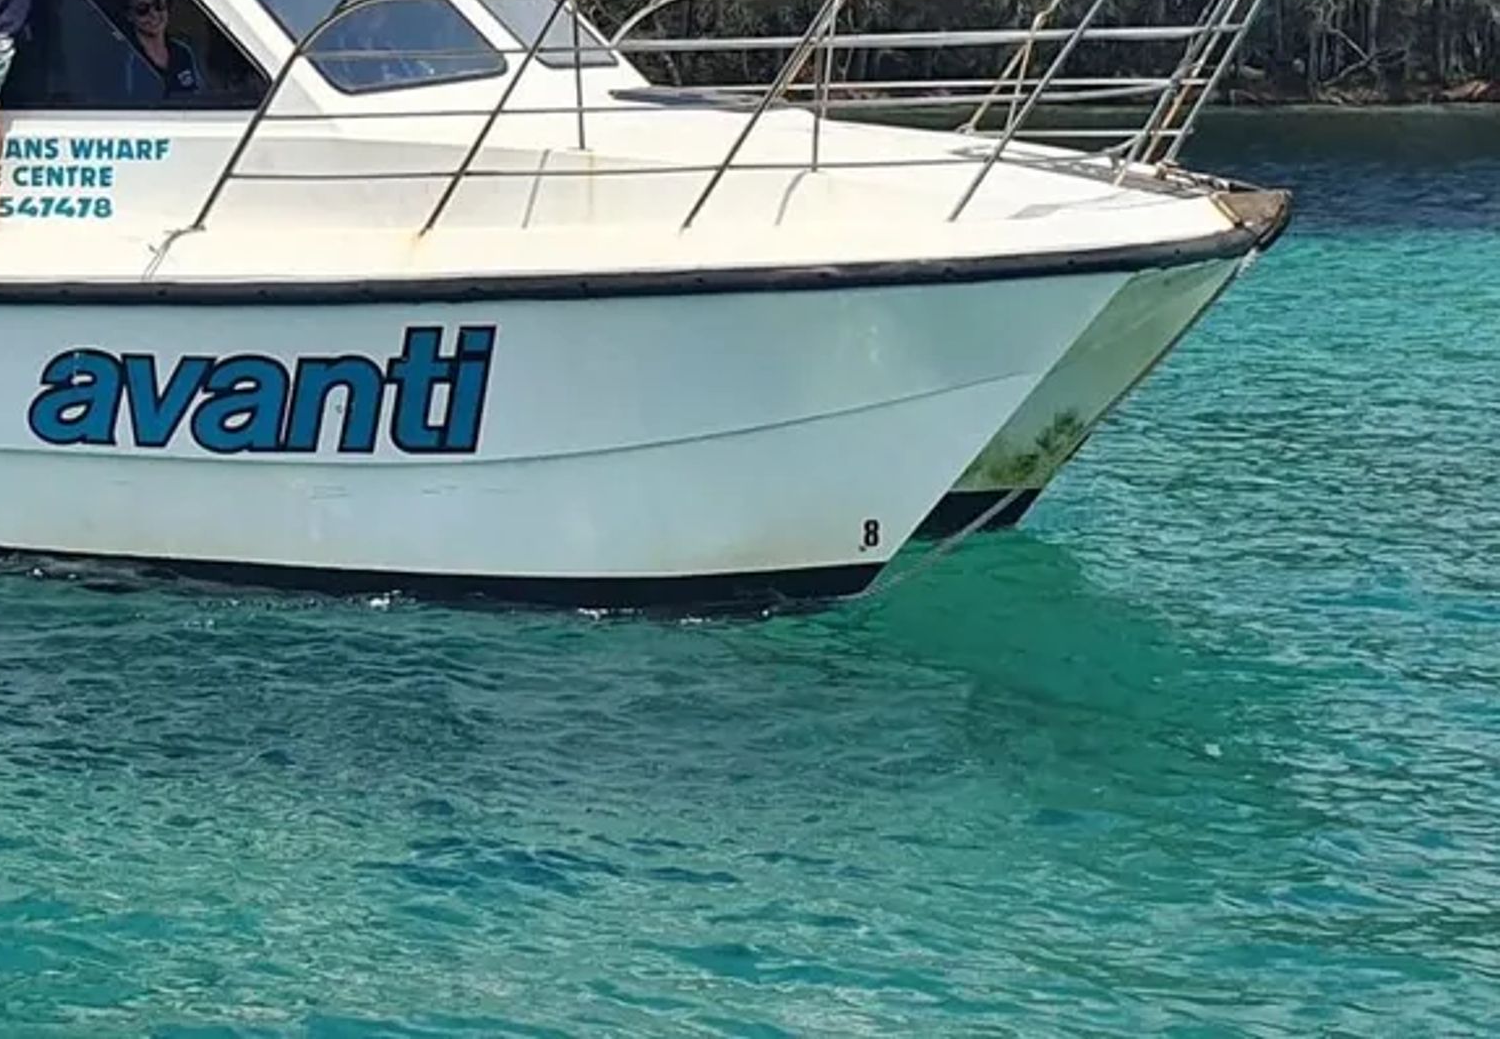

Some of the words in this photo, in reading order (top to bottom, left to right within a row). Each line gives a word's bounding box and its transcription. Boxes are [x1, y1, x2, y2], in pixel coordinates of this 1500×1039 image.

[69, 137, 170, 160] WHARF
[12, 165, 113, 187] CENTRE
[28, 325, 497, 455] avanti
[864, 519, 879, 547] 8
